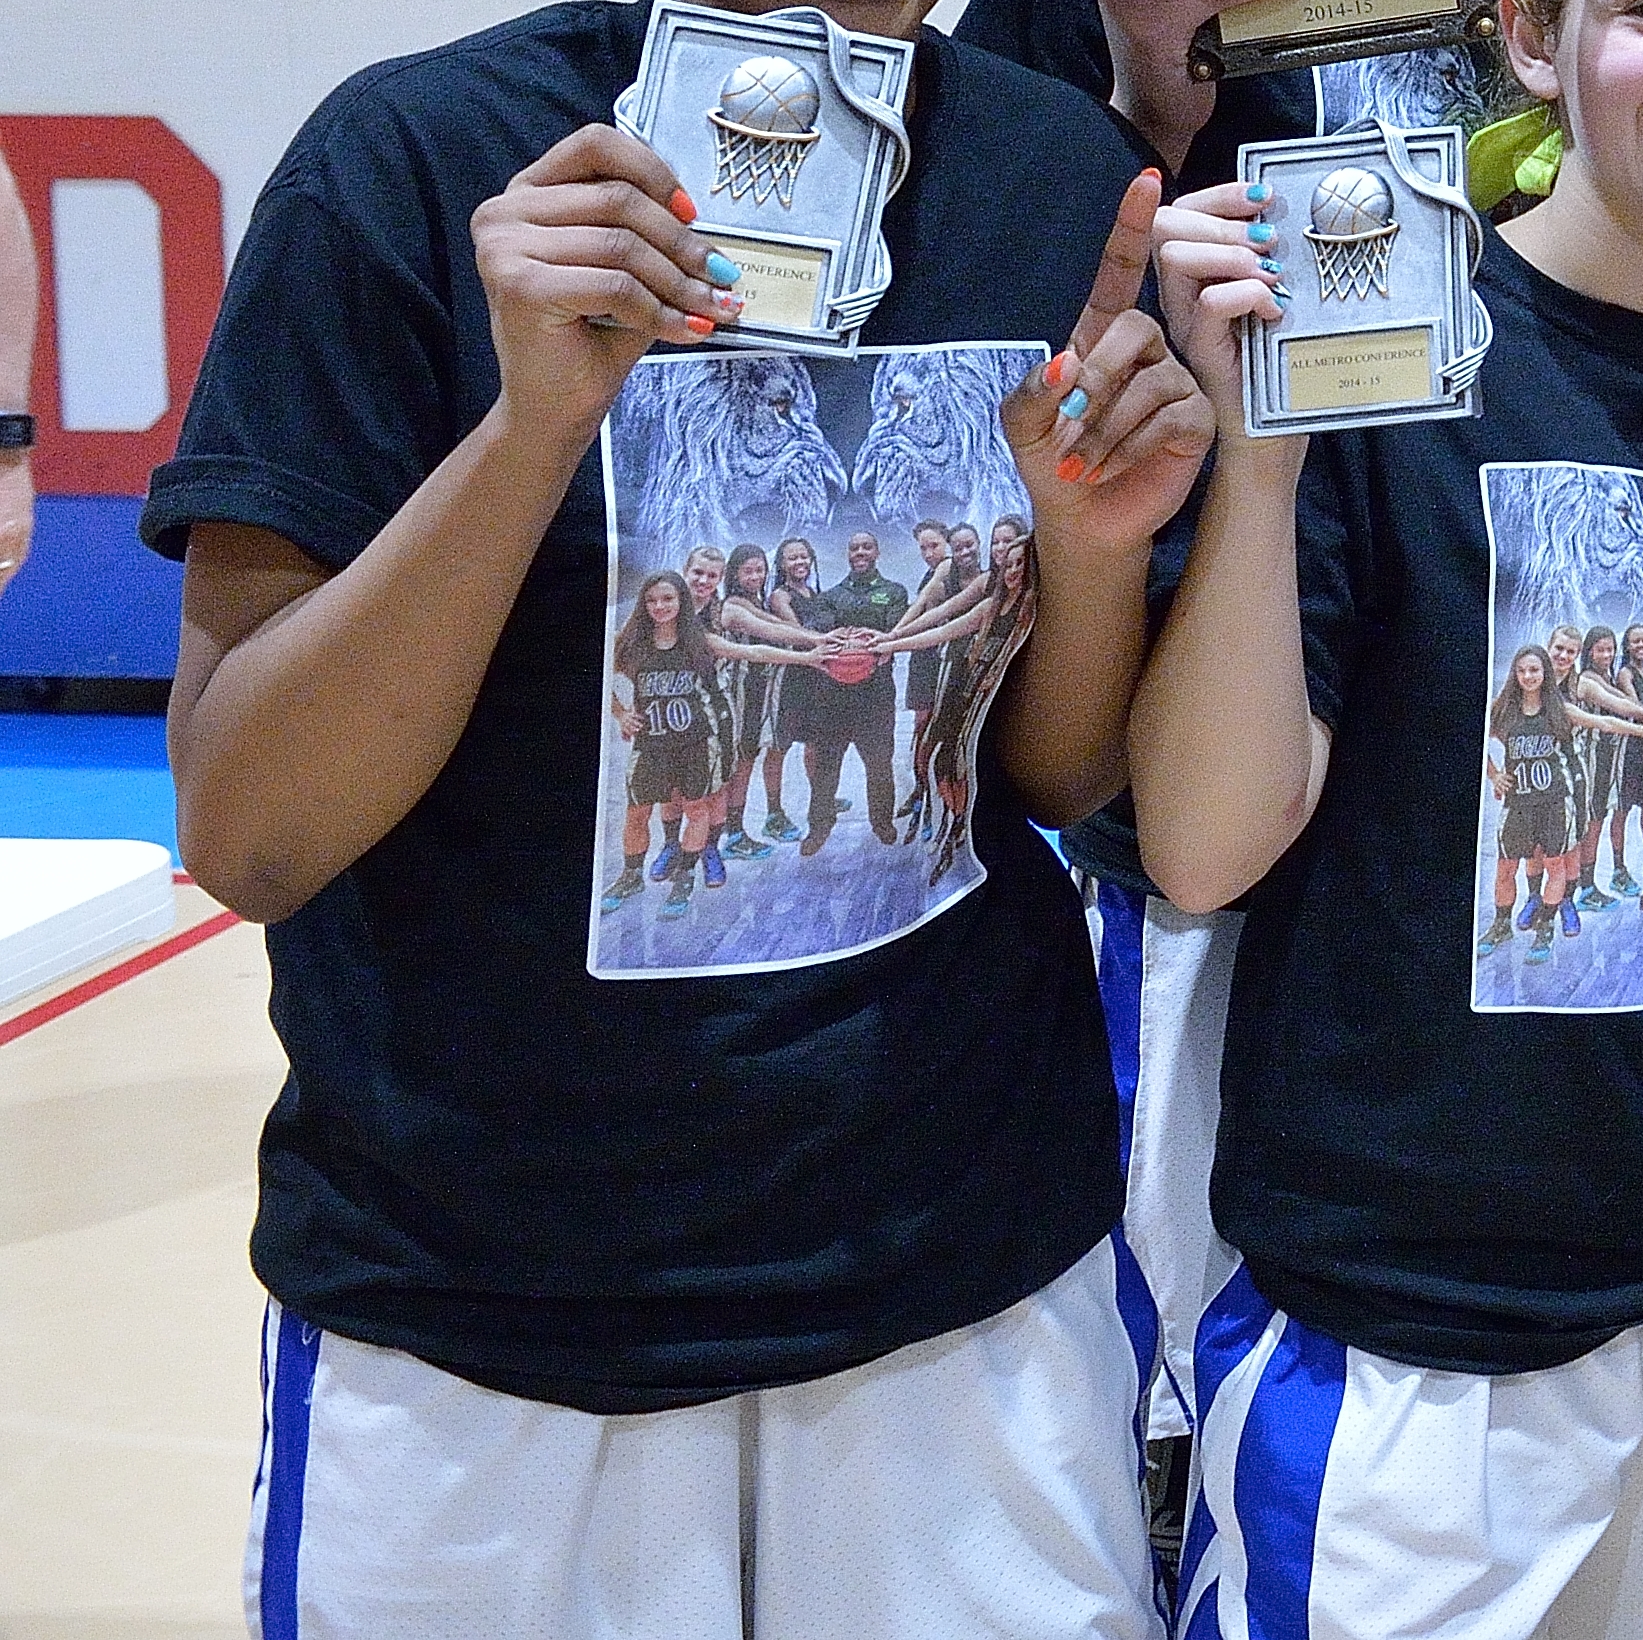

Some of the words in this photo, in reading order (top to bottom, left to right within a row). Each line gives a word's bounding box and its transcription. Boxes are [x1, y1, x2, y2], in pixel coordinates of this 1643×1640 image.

[744, 289, 757, 300] 15
[1291, 359, 1312, 370] ALL
[1314, 355, 1353, 367] METRO
[1354, 348, 1426, 363] CONFERENCE
[1338, 378, 1360, 389] 2014
[645, 698, 692, 736] 10
[1513, 759, 1552, 795] 10
